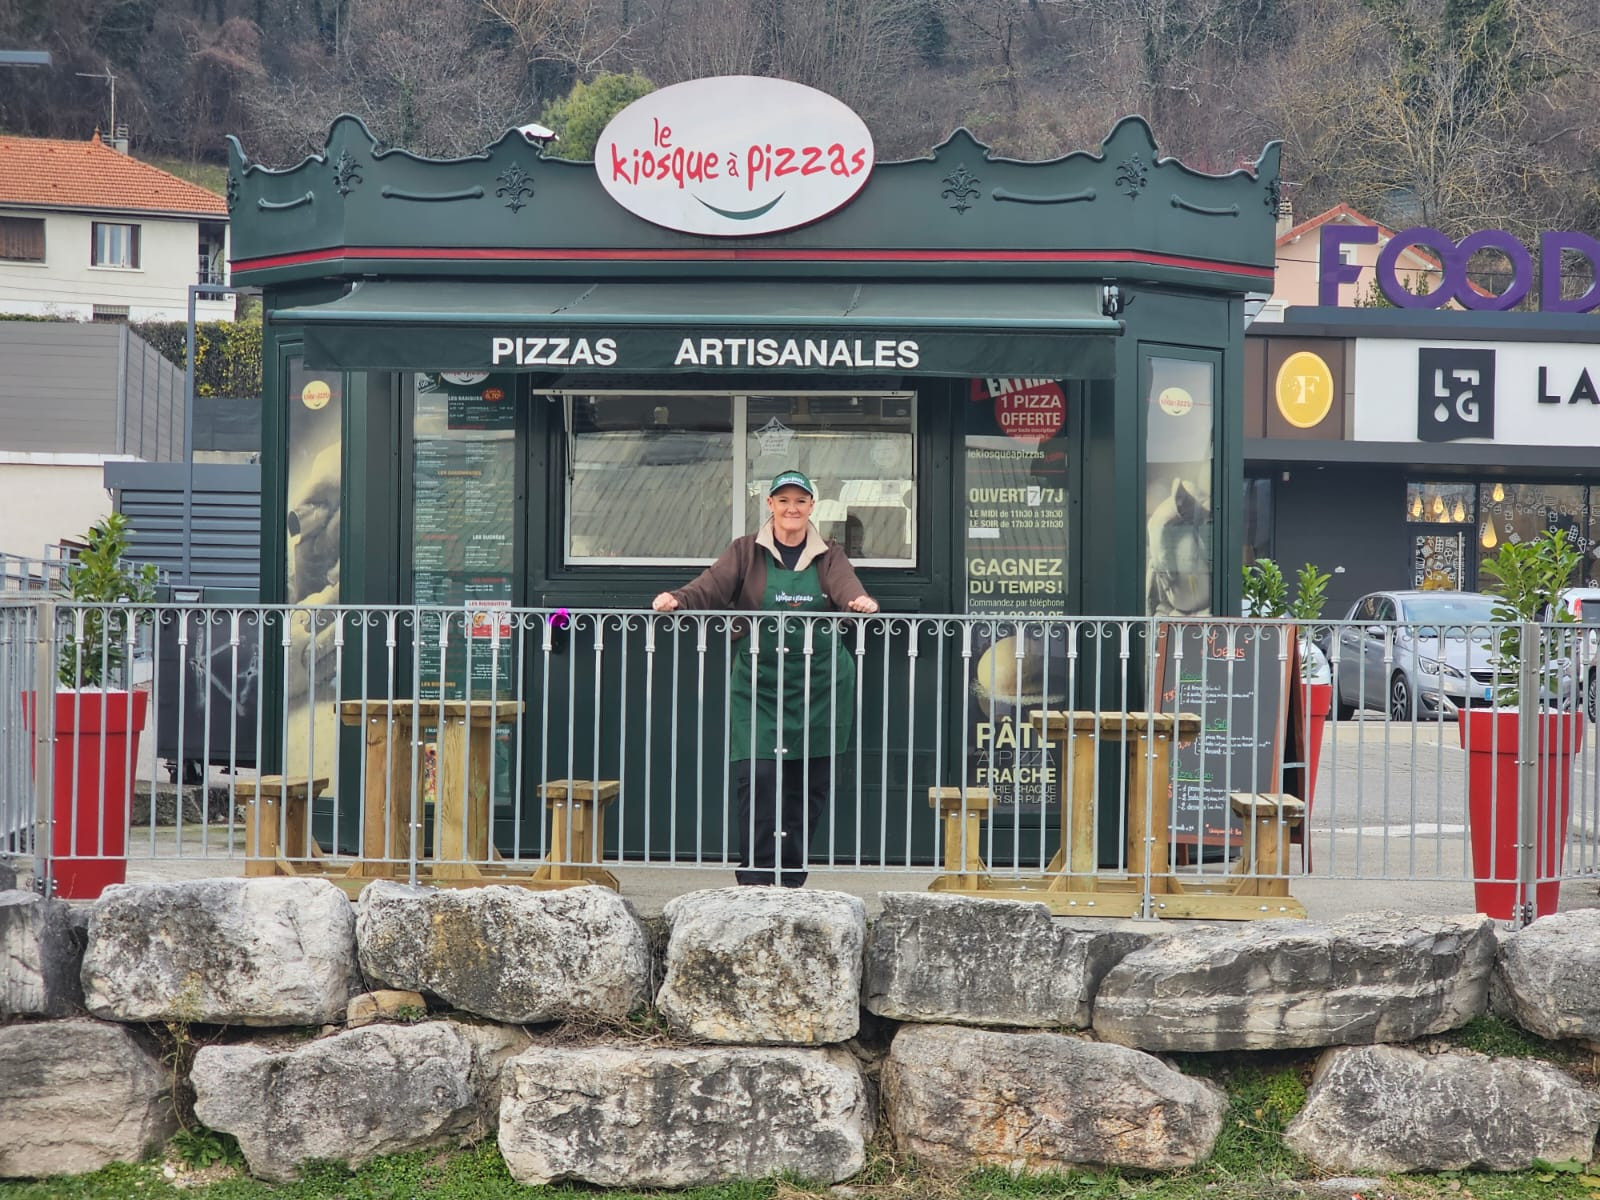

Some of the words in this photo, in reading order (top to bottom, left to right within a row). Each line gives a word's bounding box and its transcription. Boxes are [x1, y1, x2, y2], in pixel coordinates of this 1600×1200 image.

[654, 117, 672, 148] le
[611, 143, 719, 189] kiosque
[726, 152, 739, 177] à
[747, 143, 865, 191] pizzas
[492, 337, 617, 365] PIZZAS
[674, 338, 920, 368] ARTISANALES
[1001, 396, 1008, 408] 1
[1013, 395, 1062, 408] PIZZA
[1001, 412, 1061, 426] OFFERTE
[969, 488, 1026, 503] OUVERT
[969, 510, 980, 518] LE
[980, 510, 998, 518] MIDI
[1000, 510, 1008, 518] de
[1010, 510, 1032, 518] 11h30
[1041, 510, 1063, 518] 13h30
[969, 520, 980, 528] LE
[980, 520, 999, 528] SOIR
[1000, 520, 1009, 528] de
[969, 558, 1062, 576] GAGNEZ
[969, 580, 994, 594] DU
[969, 599, 1014, 607] Commandez
[1015, 600, 1027, 608] par
[1029, 598, 1064, 608] téléphone
